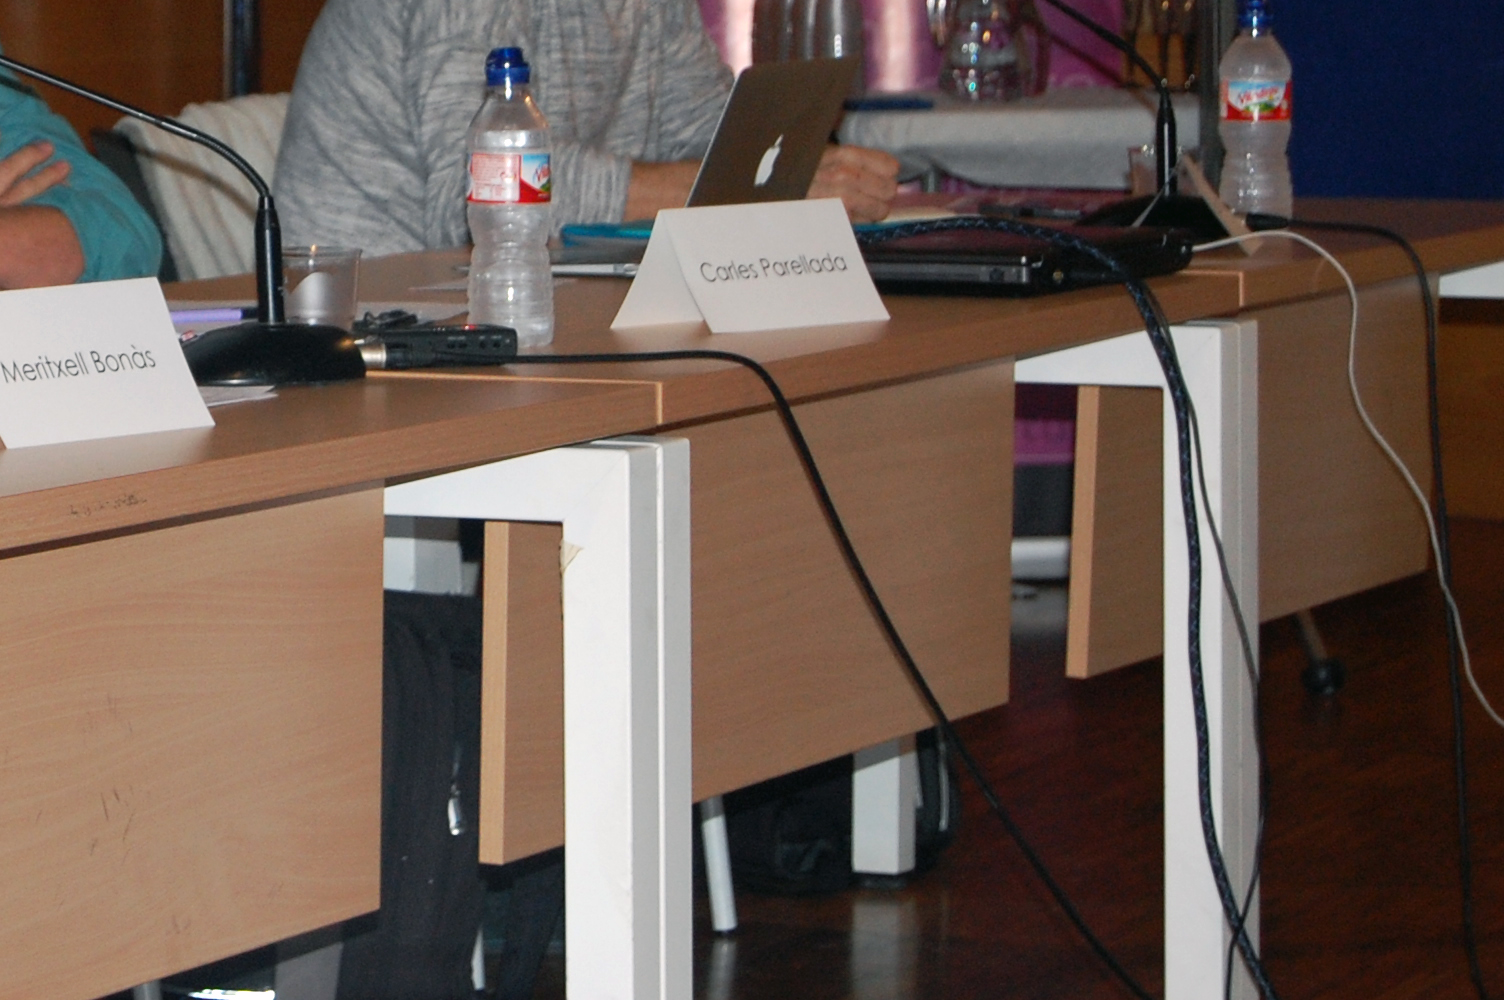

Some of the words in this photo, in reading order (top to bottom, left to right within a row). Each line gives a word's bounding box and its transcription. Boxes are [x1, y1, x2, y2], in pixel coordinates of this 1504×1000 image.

[699, 259, 758, 283] Carles
[760, 252, 848, 279] Parellada
[0, 351, 89, 384] Meritxell
[90, 344, 156, 374] Bonàs
